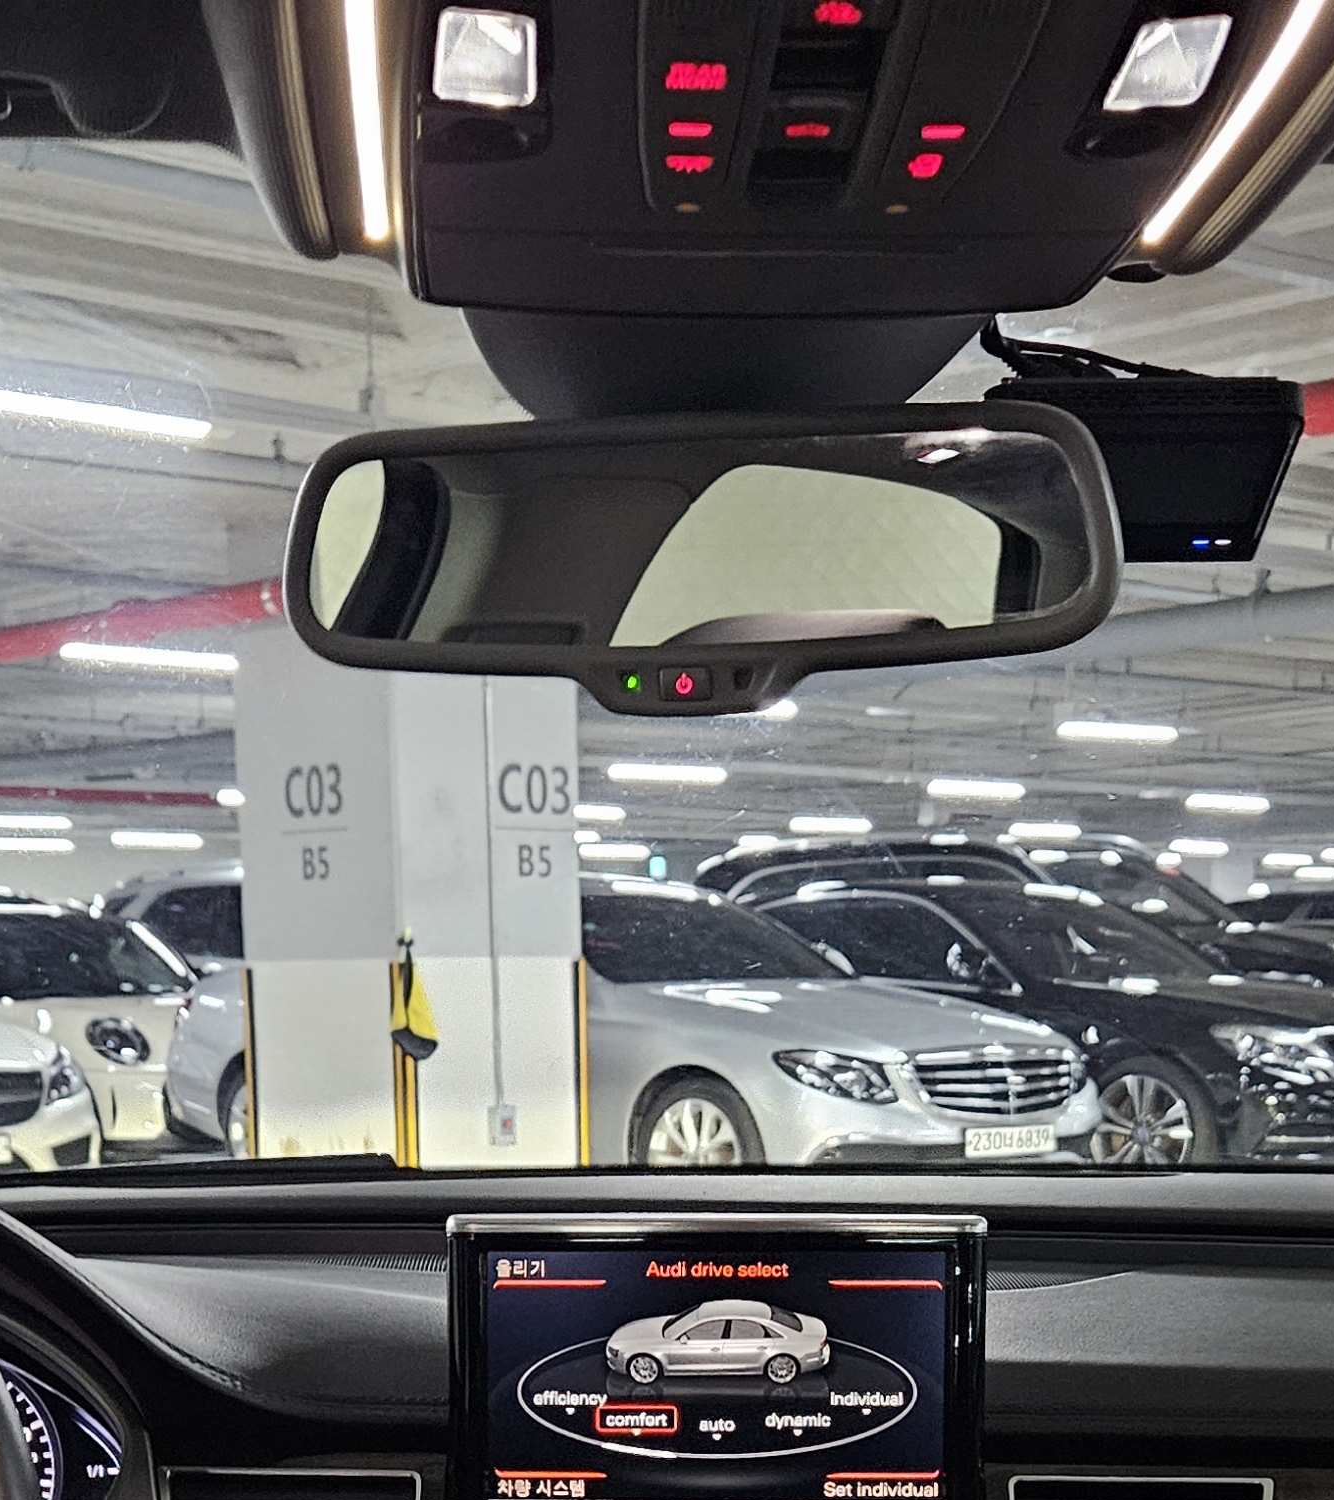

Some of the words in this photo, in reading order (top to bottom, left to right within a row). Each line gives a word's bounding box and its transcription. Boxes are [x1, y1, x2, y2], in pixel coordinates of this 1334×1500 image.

[285, 763, 343, 818] C03
[498, 763, 571, 815] C03
[302, 846, 330, 880] B5
[518, 844, 552, 878] B5
[646, 1260, 687, 1278] Audi
[691, 1260, 734, 1278] drive
[737, 1260, 789, 1278] select
[533, 1391, 608, 1407] efficiency
[830, 1391, 904, 1407] individual
[606, 1411, 668, 1427] comfort
[699, 1418, 736, 1433] auto
[765, 1412, 832, 1430] dynamic
[497, 1479, 532, 1498] 차량
[535, 1479, 586, 1498] 시스템
[823, 1481, 853, 1498] Set
[856, 1481, 939, 1498] individual
